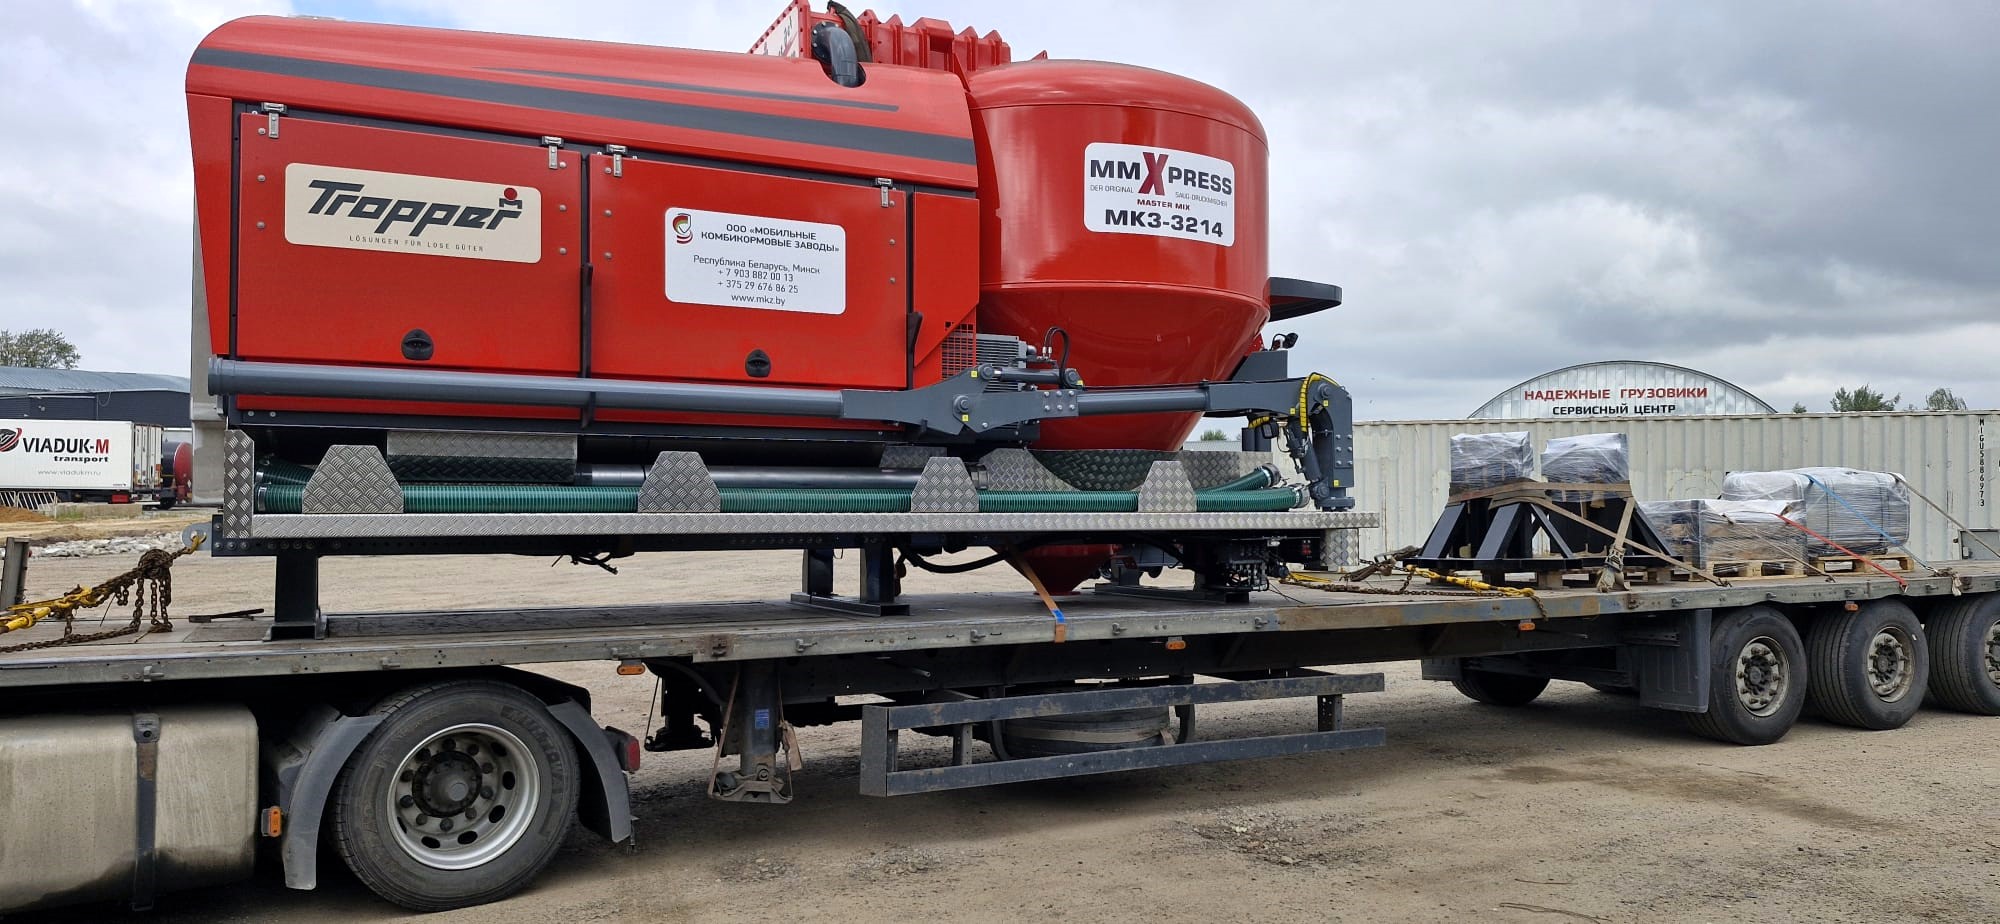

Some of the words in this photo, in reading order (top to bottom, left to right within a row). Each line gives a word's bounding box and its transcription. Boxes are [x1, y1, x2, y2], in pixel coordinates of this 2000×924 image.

[1090, 184, 1103, 192] DER
[1104, 185, 1134, 194] ORIGINAL
[308, 179, 523, 237] Tropper
[1137, 198, 1173, 209] MASTER
[1175, 202, 1190, 211] MIX
[1105, 208, 1223, 238] MK3-3214
[726, 223, 747, 233] ООО
[750, 226, 817, 241] «МОБИЛЬНЫЕ
[349, 235, 399, 245] LÖSUNGEN
[404, 239, 422, 247] FÜR
[427, 242, 450, 250] LOSE
[455, 244, 484, 252] GÜTER
[701, 231, 792, 248] КОМБИКОРМОВЫЕ
[794, 240, 840, 252] ЗАВОДЫ»
[693, 254, 746, 267] Республика
[748, 259, 789, 273] Беларусь,
[792, 263, 820, 274] Минск
[725, 268, 731, 276] 7
[733, 269, 750, 278] 903
[752, 270, 768, 280] 882
[770, 271, 781, 281] 00
[784, 272, 793, 282] 13
[726, 279, 742, 289] 375
[744, 280, 755, 290] 29
[757, 282, 773, 292] 676
[775, 283, 786, 293] 86
[788, 284, 799, 294] 25
[731, 294, 786, 307] www.mkz.by
[1524, 388, 1611, 402] НАДЕЖНЫЕ
[1620, 387, 1708, 399] ГРУЗОВИКИ
[1552, 403, 1629, 415] СЕРВИСНЫЙ
[1634, 404, 1676, 415] ЦЕНТР
[22, 437, 110, 454] VIADUK-M
[53, 455, 109, 463] transport
